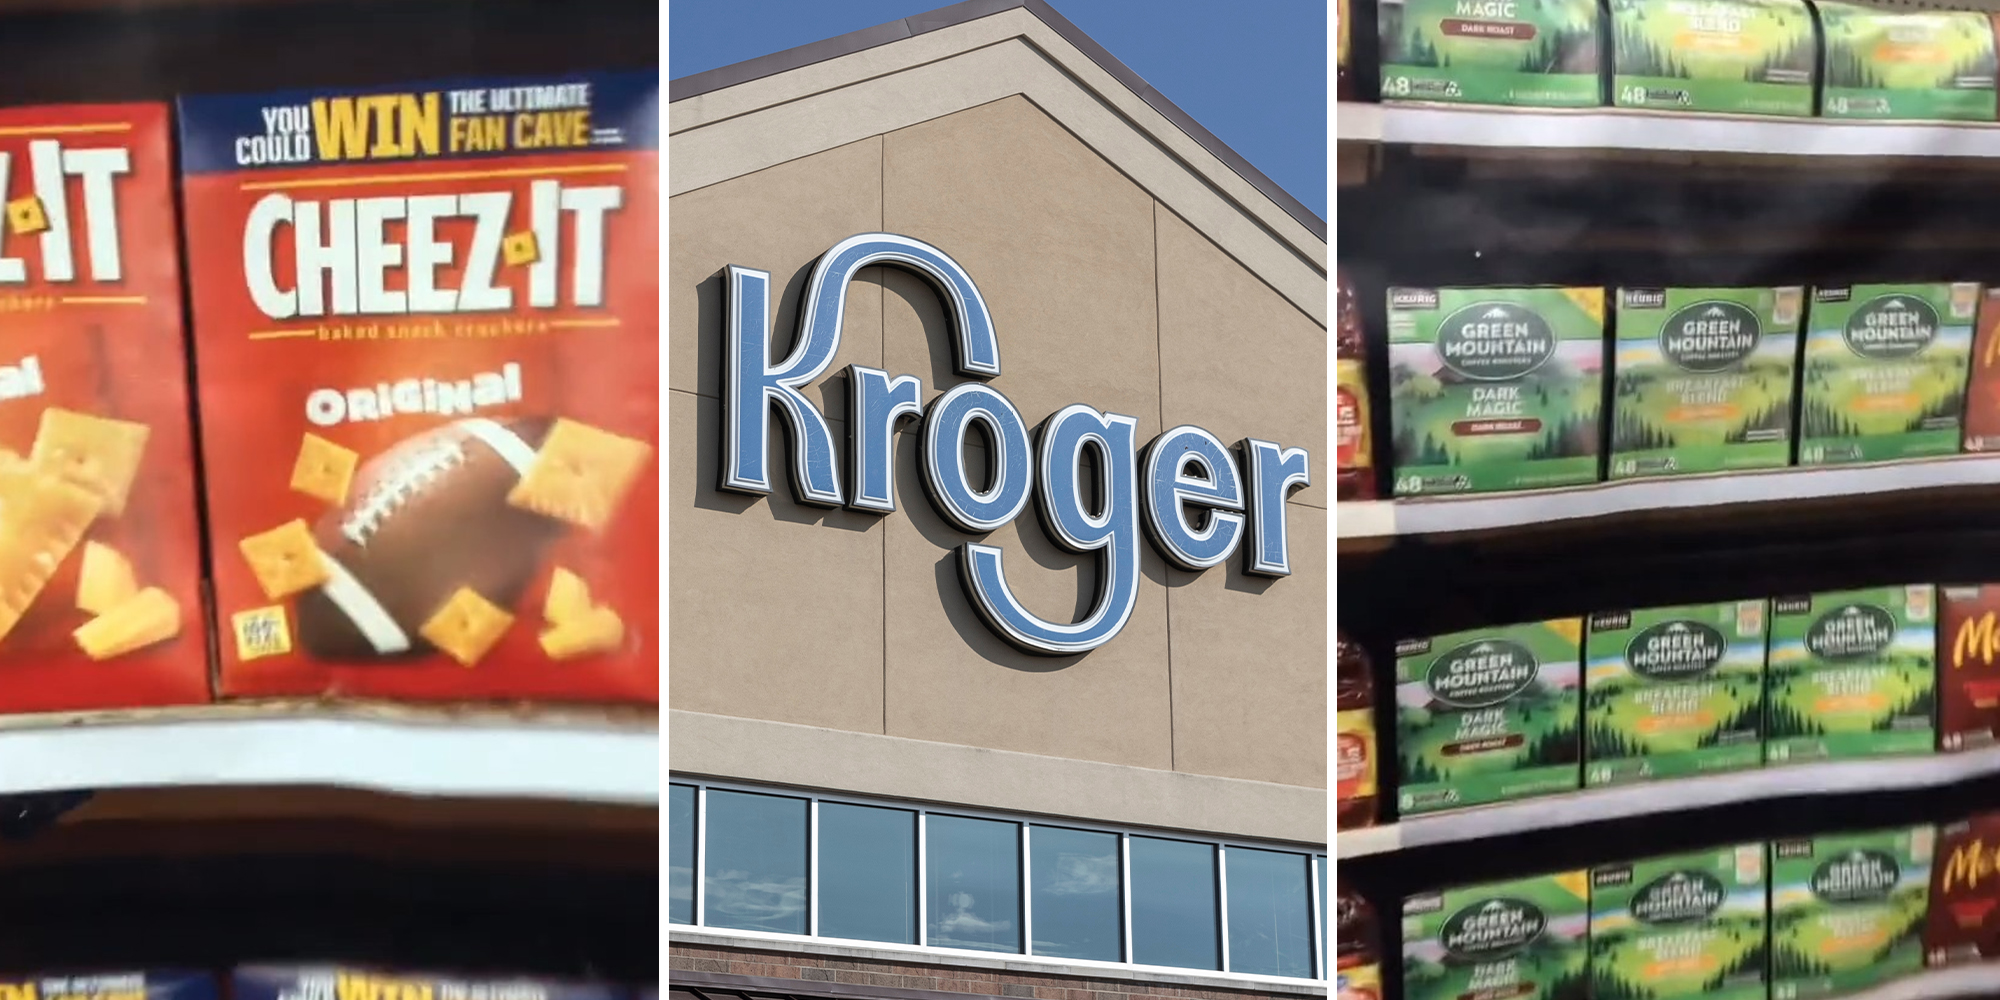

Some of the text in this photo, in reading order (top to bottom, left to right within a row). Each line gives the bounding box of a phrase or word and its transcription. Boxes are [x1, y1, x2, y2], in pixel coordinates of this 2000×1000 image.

[1455, 0, 1516, 17] MAGIC
[1382, 76, 1411, 95] 48
[1621, 85, 1645, 103] 48
[449, 83, 590, 113] THE ULTIMATE
[262, 105, 309, 134] YOU
[312, 92, 440, 161] WIN
[449, 115, 504, 152] FAN
[513, 111, 588, 149] CAVE
[235, 134, 310, 165] COULD
[1683, 319, 1740, 335] GREEN
[1865, 311, 1920, 326] GREEN
[1461, 323, 1528, 339] GREEN
[1851, 325, 1931, 343] MOUNTAIN
[1445, 338, 1546, 356] MOUNTAIN
[1668, 334, 1752, 353] MOUNTAIN
[1473, 387, 1521, 401] DARK
[1466, 401, 1523, 417] MAGIC
[716, 232, 1310, 655] Kroger
[1647, 633, 1705, 651] GREEN
[1449, 653, 1512, 674] GREEN
[1634, 644, 1718, 667] MOUNTAIN
[1435, 665, 1529, 691] MOUNTAIN
